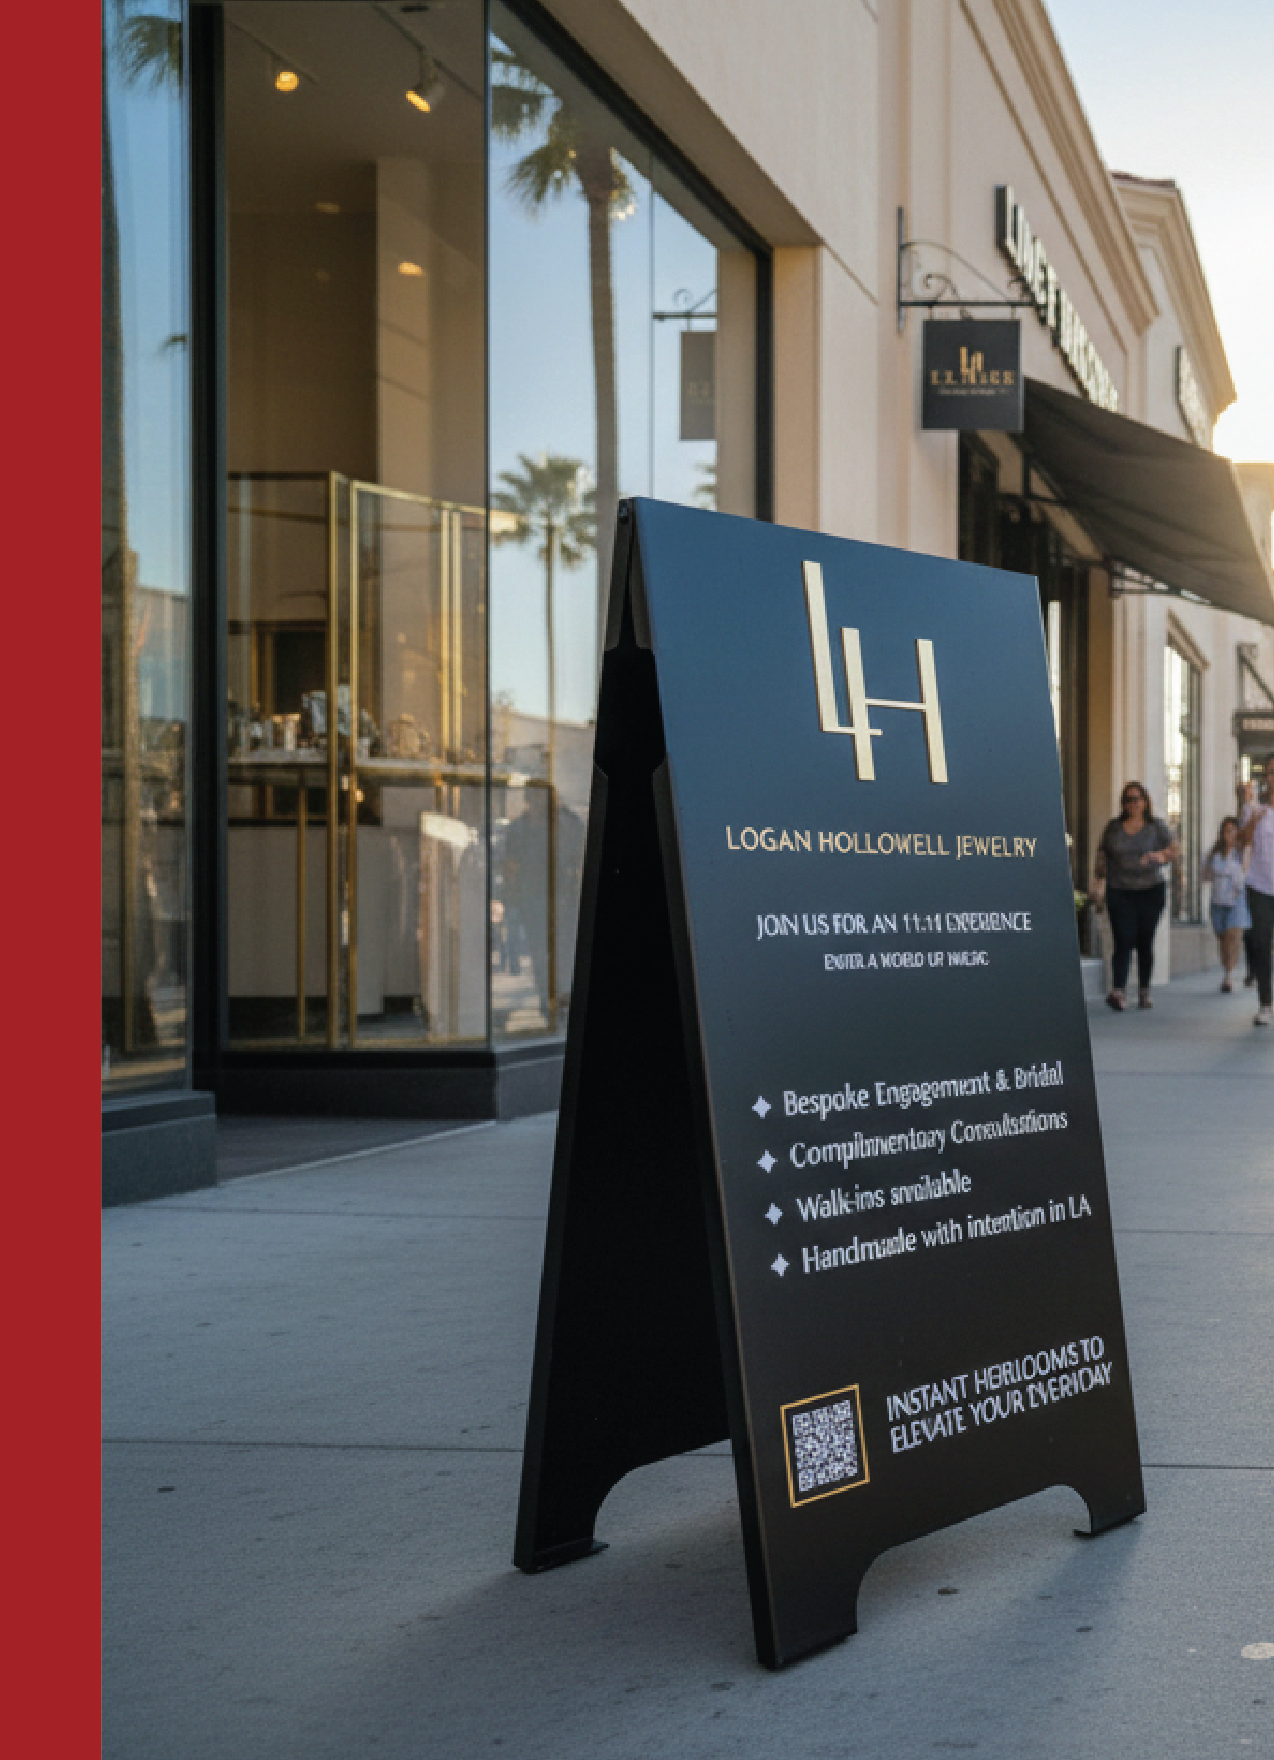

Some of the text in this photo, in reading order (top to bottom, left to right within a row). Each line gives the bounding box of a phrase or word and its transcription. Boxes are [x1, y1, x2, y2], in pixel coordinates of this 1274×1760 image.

[725, 825, 1037, 860] LOGAN HOLLOWELL JEWELRY
[756, 913, 800, 941] JOIN
[803, 913, 829, 935] US
[833, 913, 868, 935] FOR
[872, 915, 896, 933] AN
[784, 1083, 868, 1121] Bespoke
[996, 1070, 1011, 1091] &
[921, 1220, 962, 1246] with
[1049, 1198, 1066, 1223] in
[1069, 1194, 1091, 1218] LA
[887, 1374, 968, 1422] INSTANT
[1079, 1336, 1104, 1362] TO
[890, 1406, 967, 1453] ELEVATE
[968, 1389, 1025, 1426] YOUR
